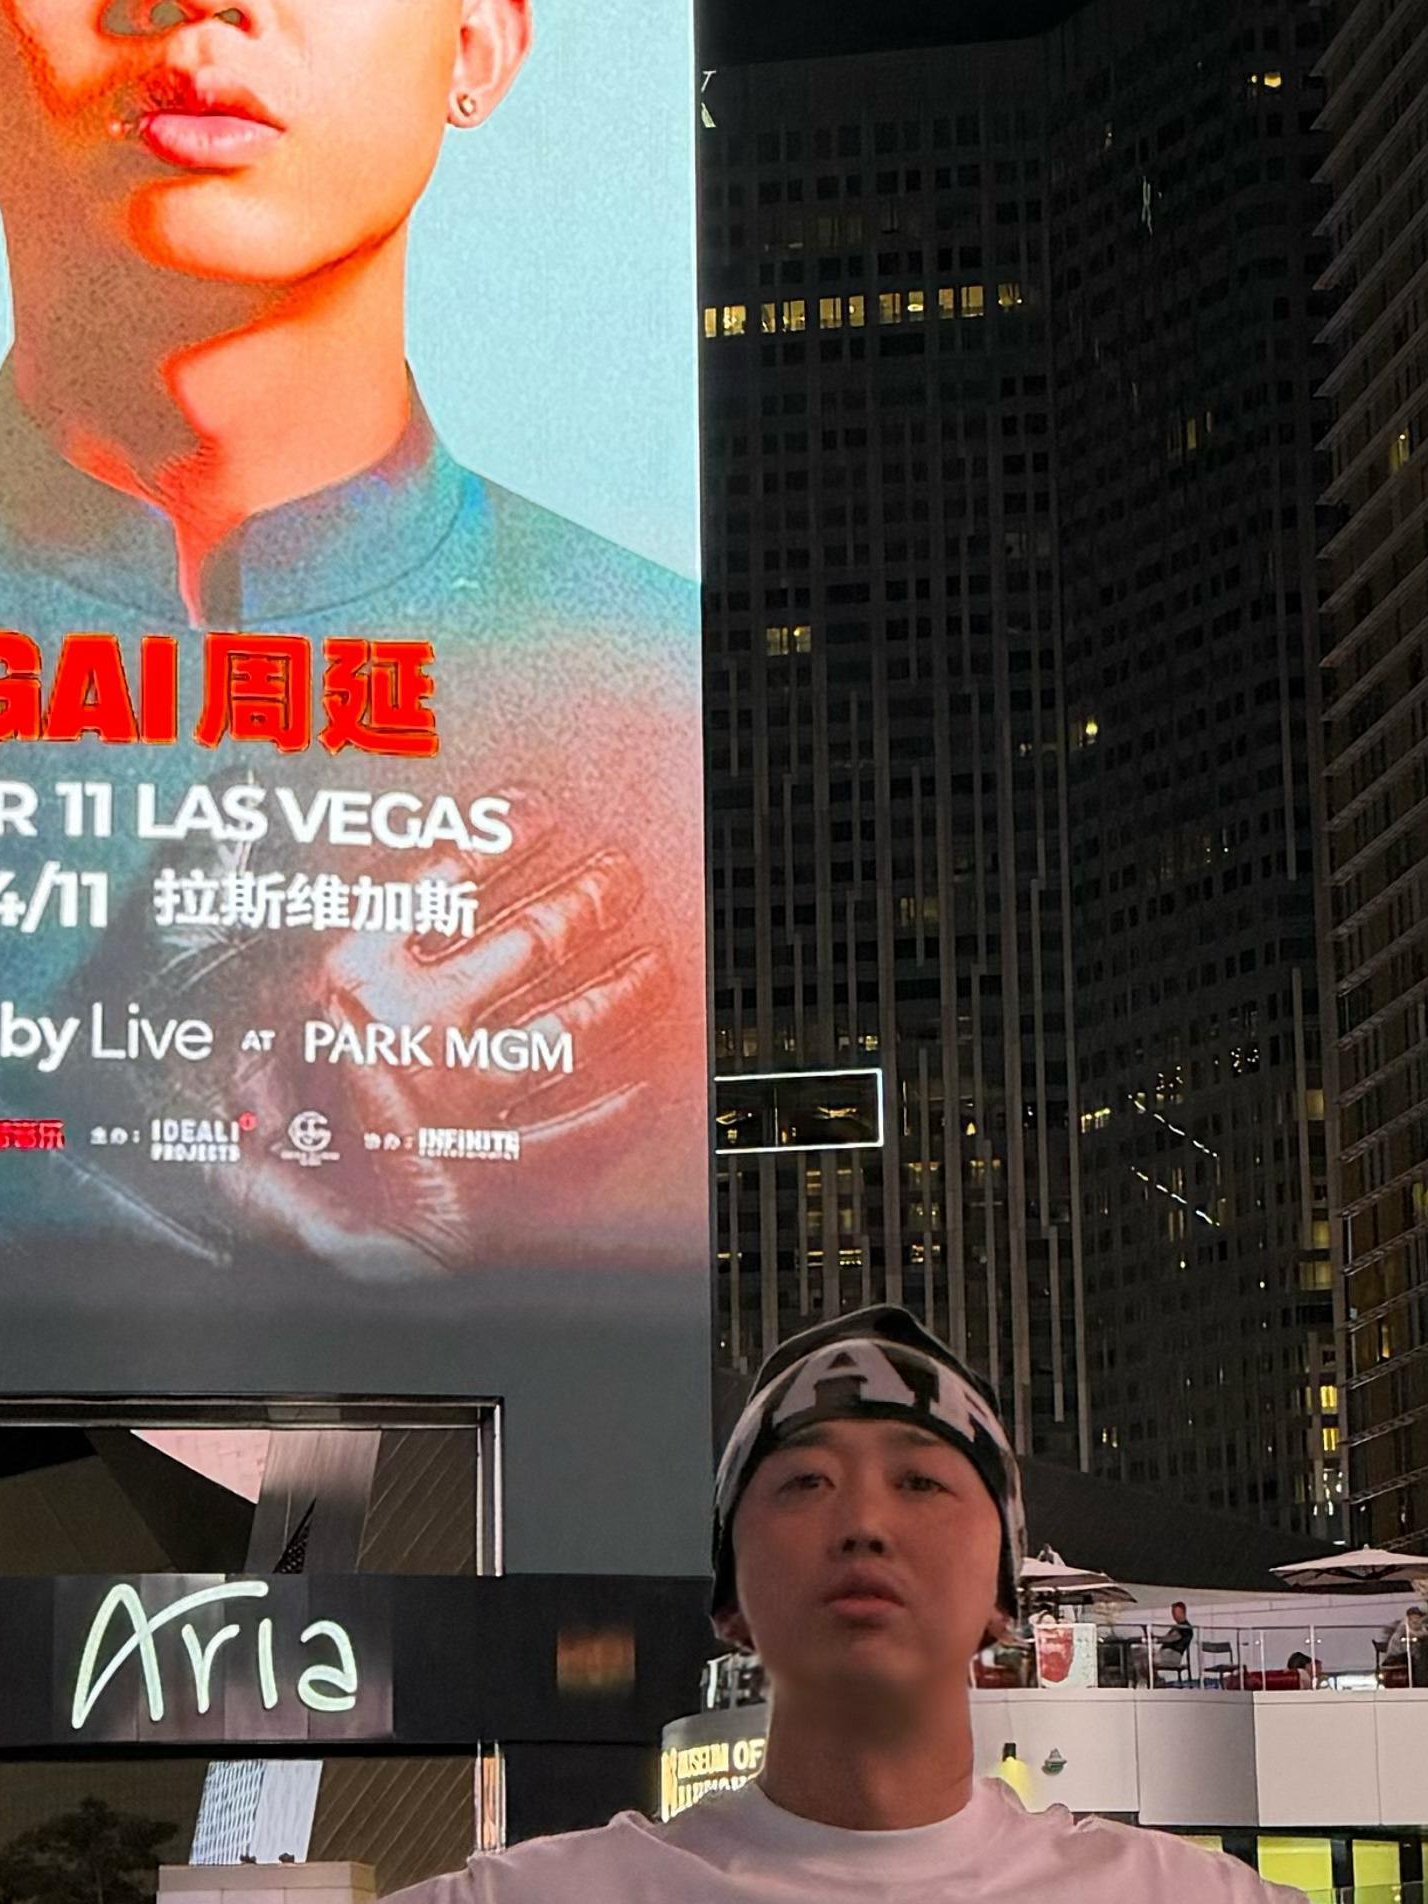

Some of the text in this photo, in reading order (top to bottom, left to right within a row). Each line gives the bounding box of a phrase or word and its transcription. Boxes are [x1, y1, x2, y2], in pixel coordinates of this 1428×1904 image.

[196, 630, 440, 759] 周延
[57, 782, 111, 839] 11
[137, 783, 267, 844] LAS
[275, 785, 513, 856] VEGAS
[153, 870, 479, 937] 拉斯维加斯
[92, 1003, 213, 1060] Live
[242, 1029, 275, 1054] AT
[304, 1020, 432, 1068] PARK
[447, 1024, 573, 1072] MGM
[70, 1581, 359, 1729] Aria
